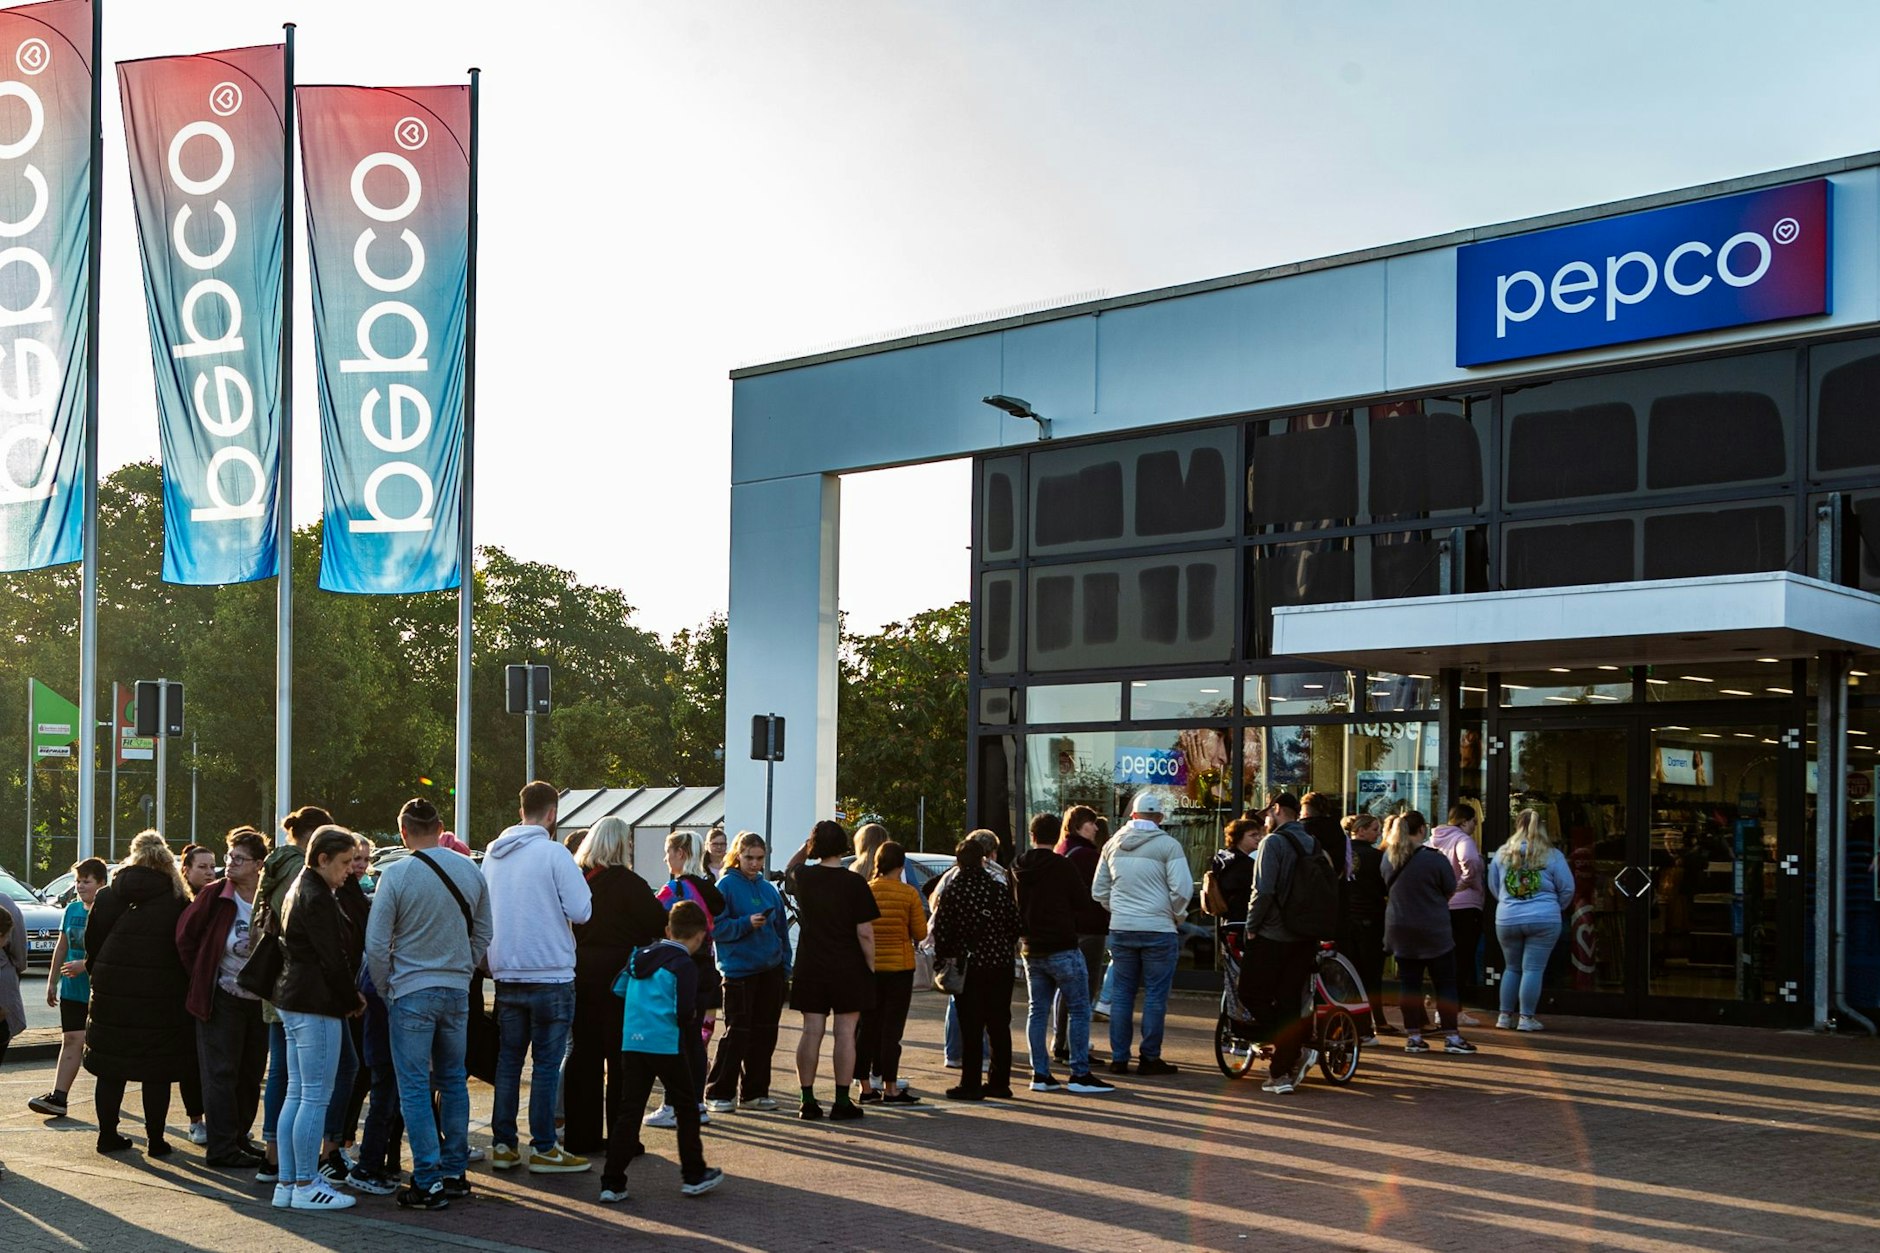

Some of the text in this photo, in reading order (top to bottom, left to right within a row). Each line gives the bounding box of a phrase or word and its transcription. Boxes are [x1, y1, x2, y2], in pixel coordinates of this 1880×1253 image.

[1496, 231, 1772, 339] pepco
[1121, 755, 1179, 779] pepco
[1668, 756, 1688, 768] Damen
